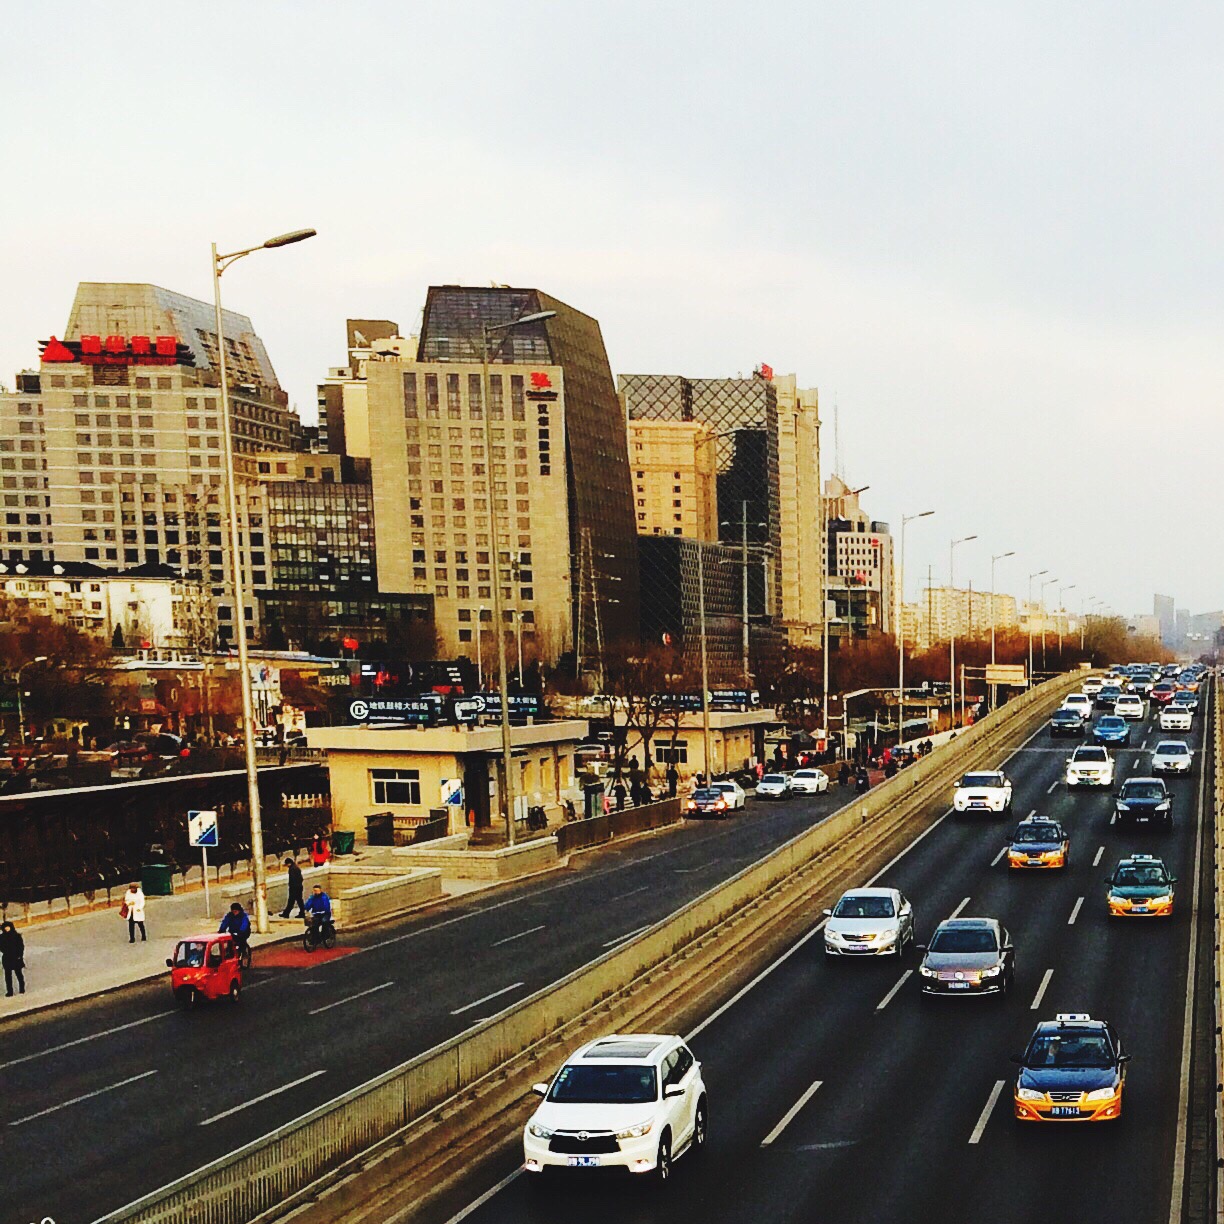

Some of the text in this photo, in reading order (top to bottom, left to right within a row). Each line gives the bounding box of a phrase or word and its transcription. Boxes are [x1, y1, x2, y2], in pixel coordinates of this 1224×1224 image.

[486, 696, 538, 705] 地铁楼大街站
